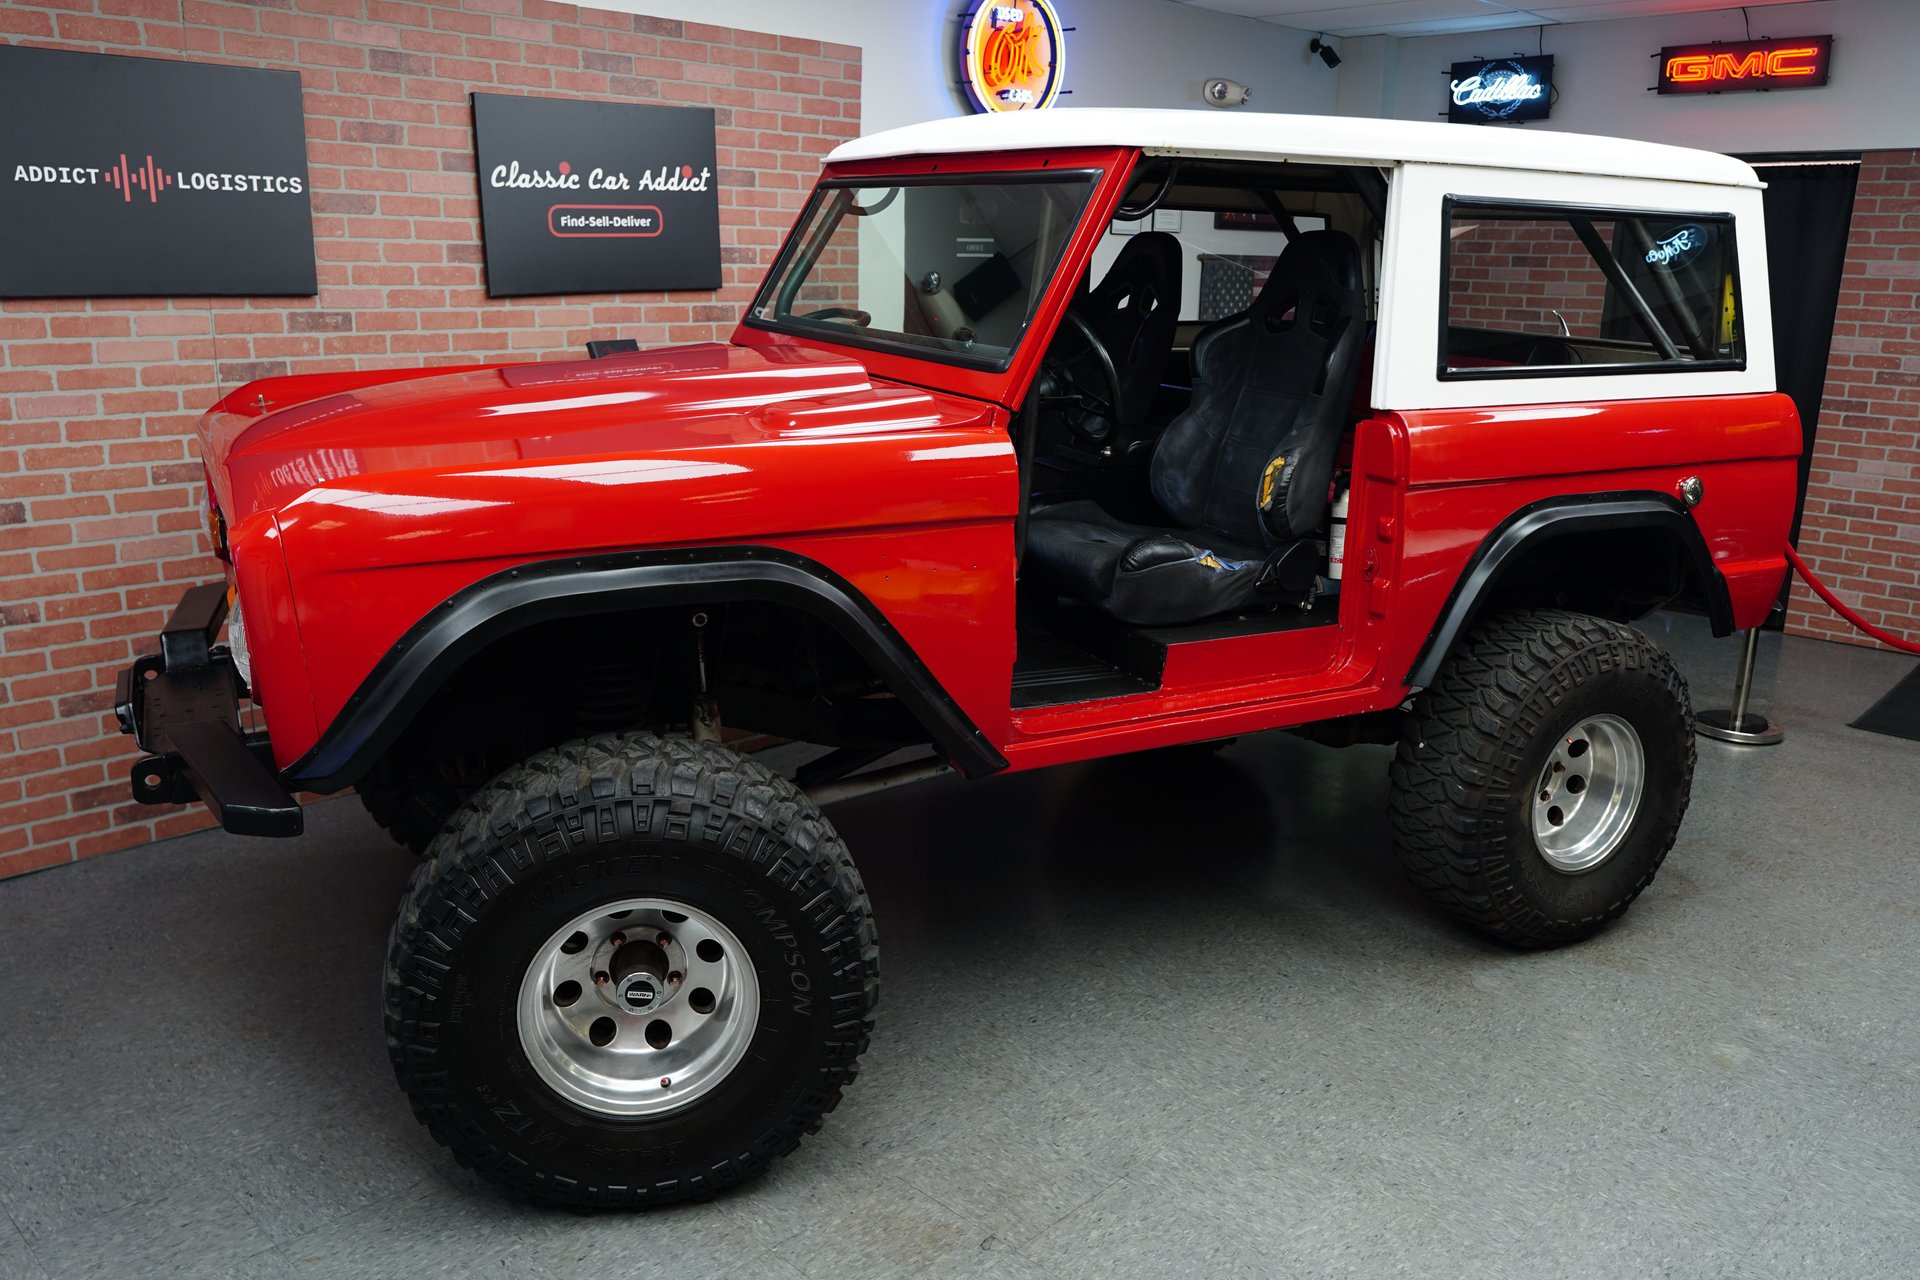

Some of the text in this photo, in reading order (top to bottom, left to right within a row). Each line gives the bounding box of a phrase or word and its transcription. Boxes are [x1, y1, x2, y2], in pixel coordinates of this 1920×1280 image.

[1666, 47, 1818, 82] GMC
[1450, 72, 1542, 105] Cadillac
[14, 165, 303, 194] ADDICT LOGISTICS
[491, 160, 711, 192] Classic Car Addict
[560, 214, 652, 227] Find-Sell-Deliver
